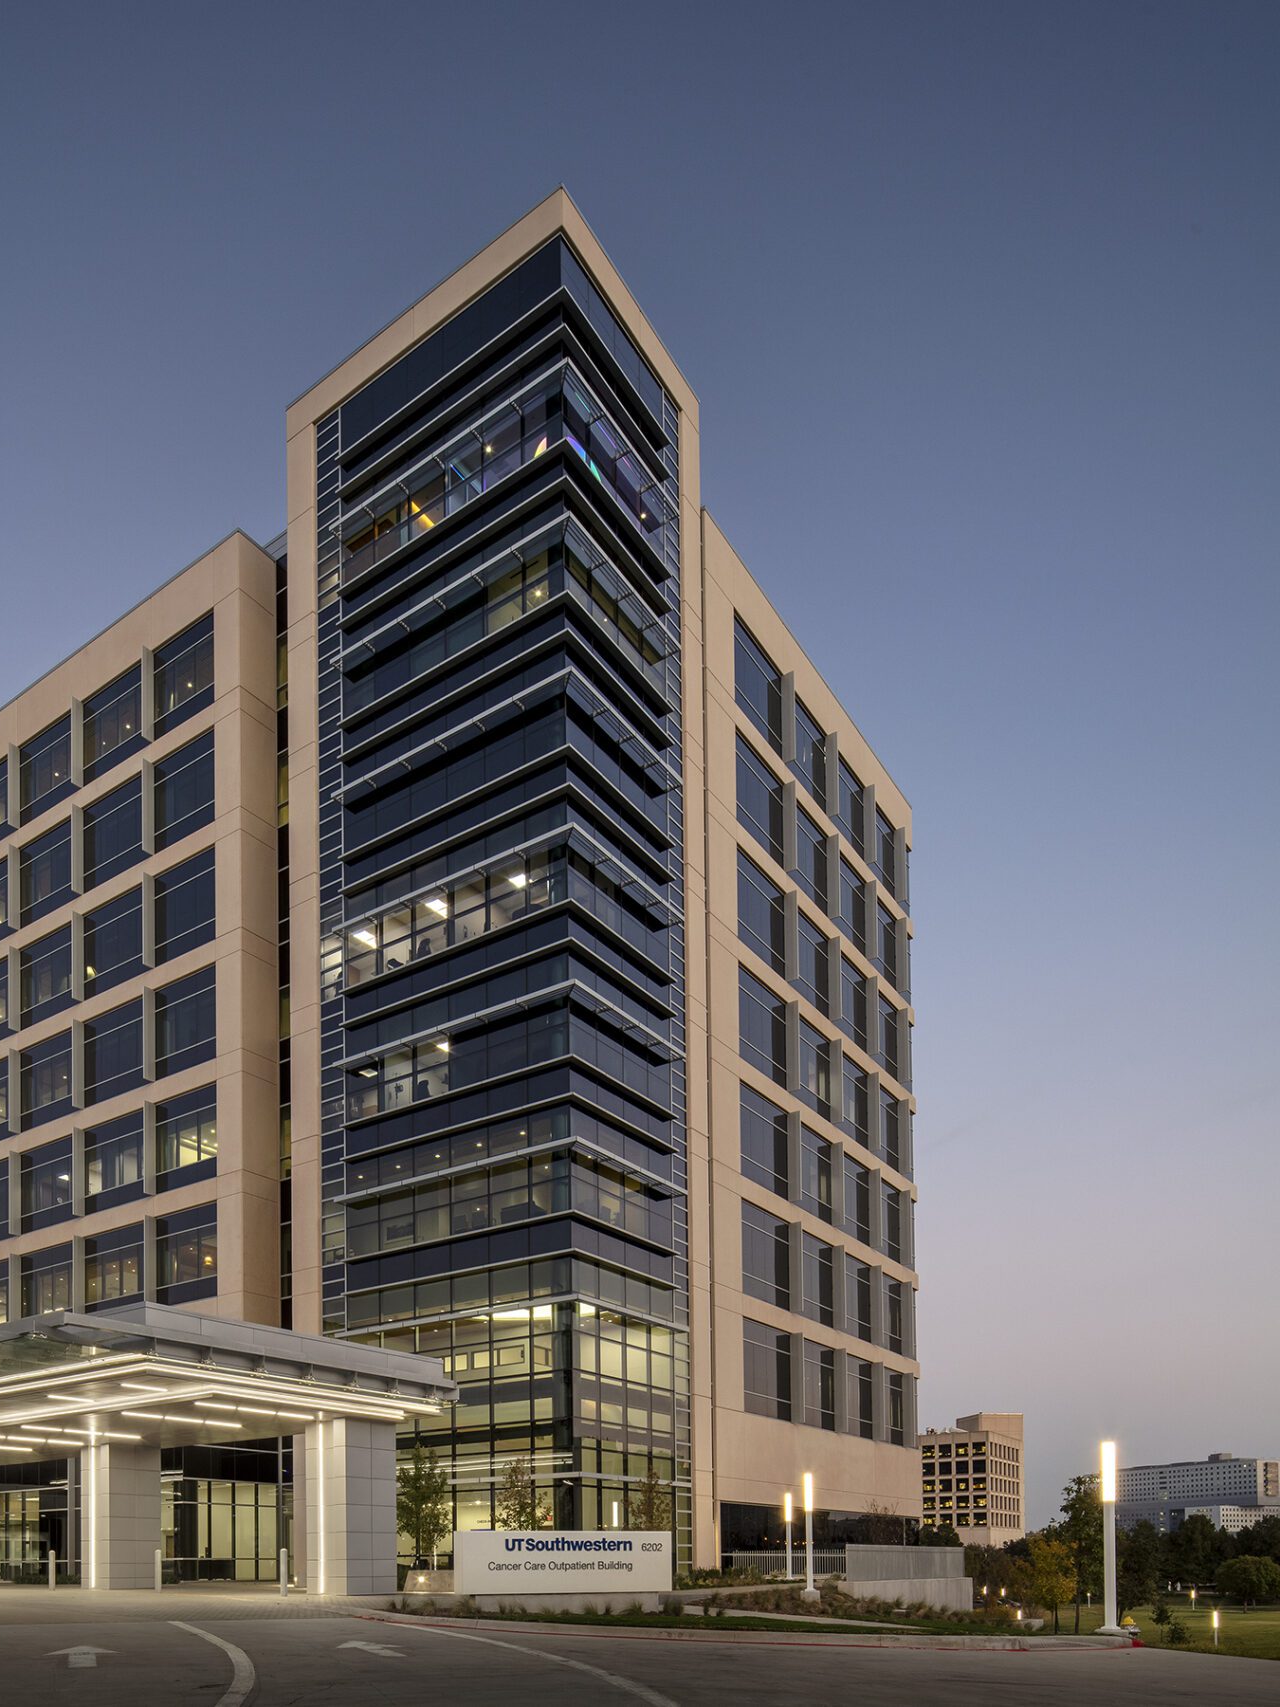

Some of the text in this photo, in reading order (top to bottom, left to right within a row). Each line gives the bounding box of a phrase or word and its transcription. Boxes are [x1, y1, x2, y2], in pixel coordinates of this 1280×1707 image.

[505, 1537, 662, 1552] UT Southwestern 6202
[488, 1561, 633, 1572] Cancer Care Outpatient Building
